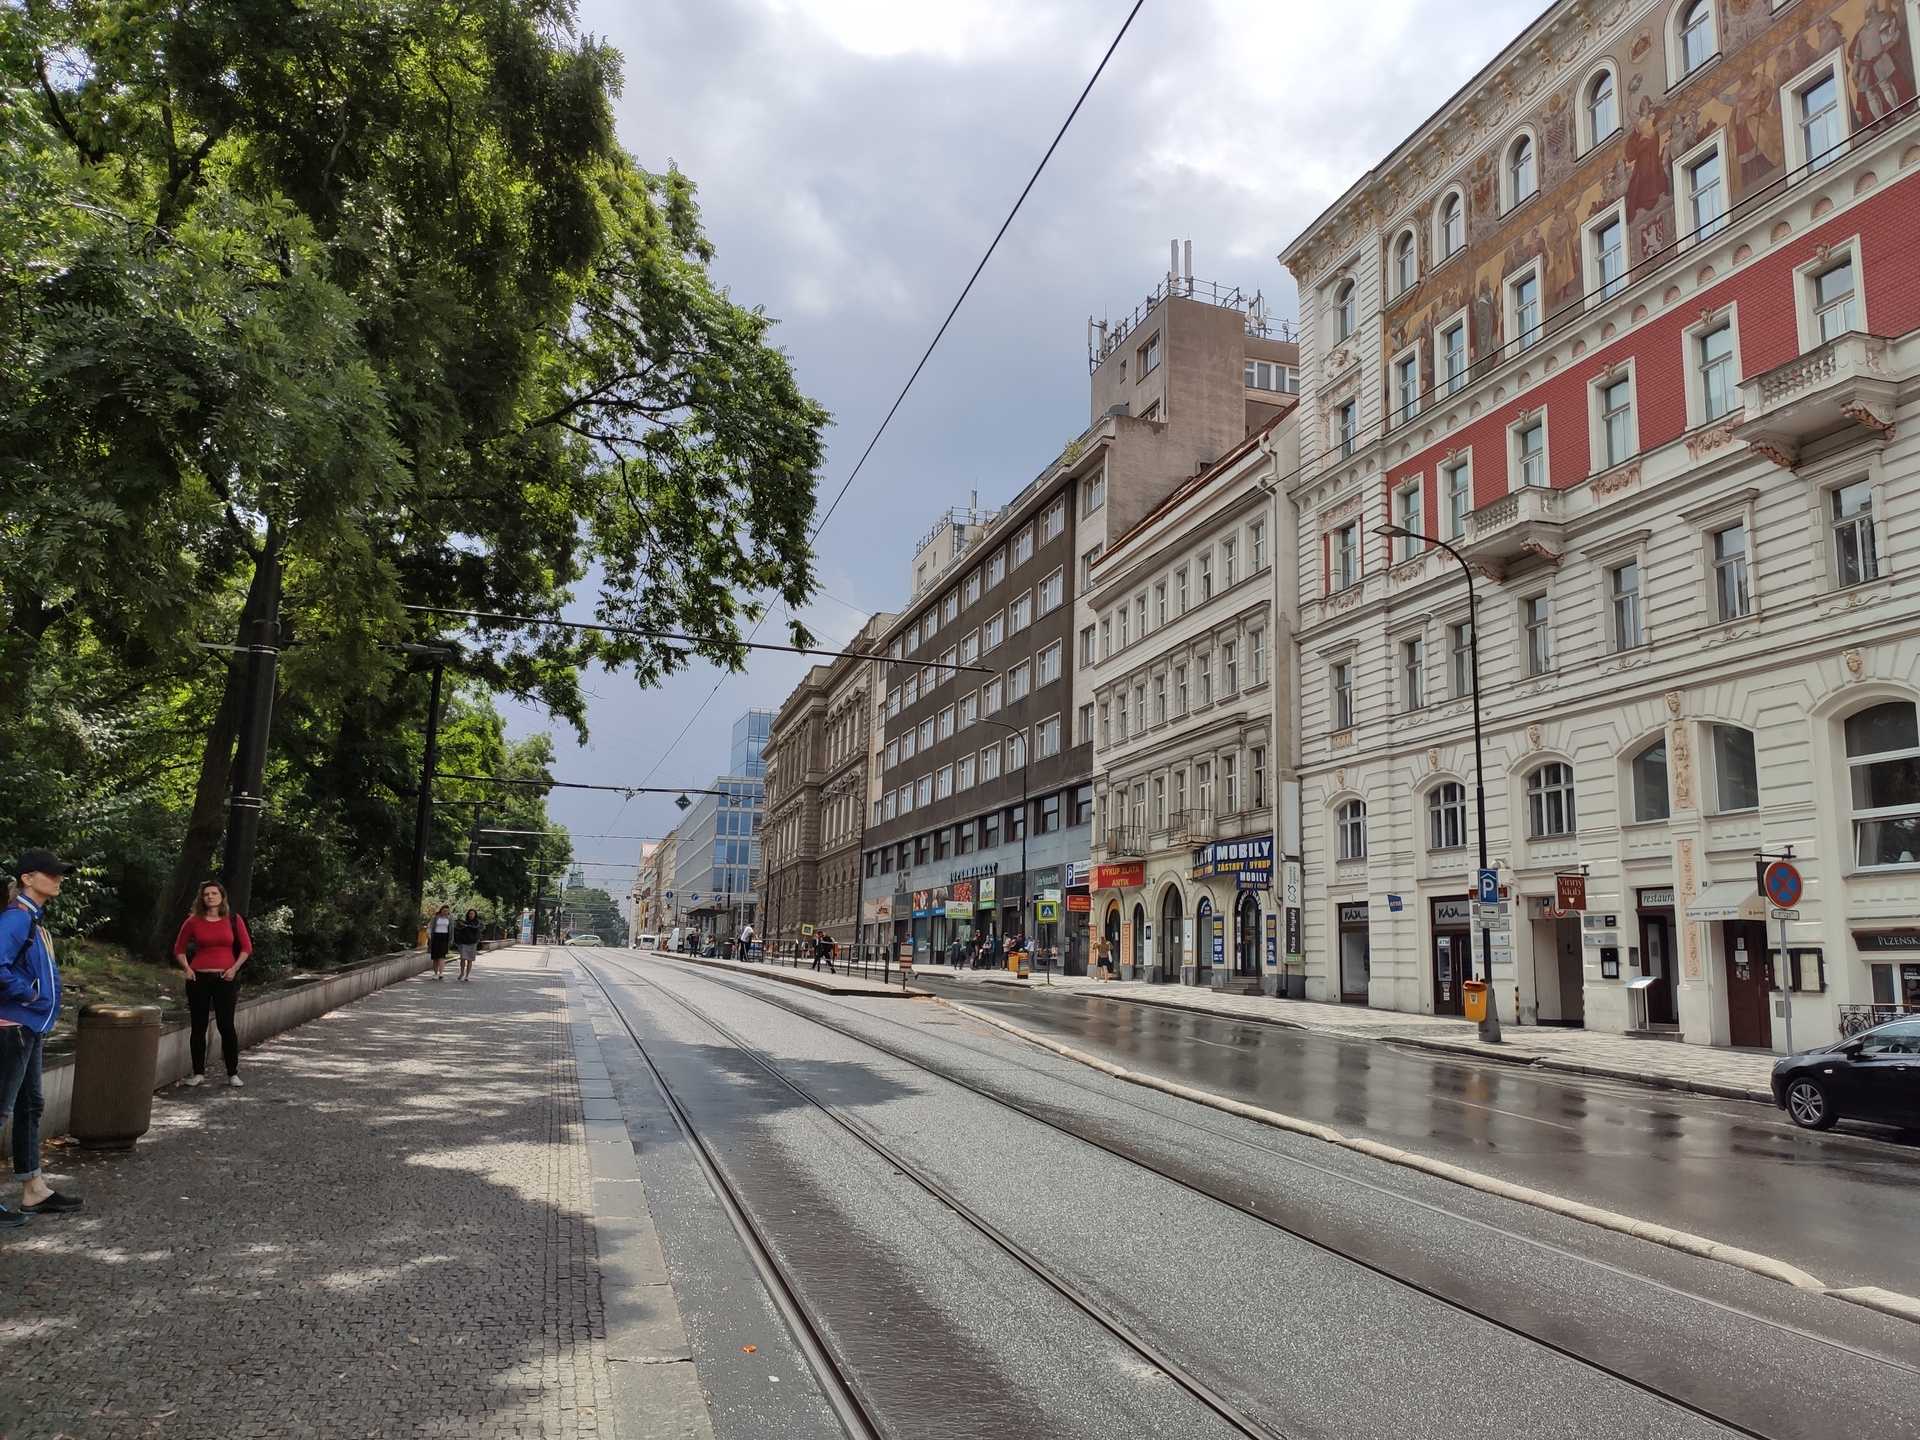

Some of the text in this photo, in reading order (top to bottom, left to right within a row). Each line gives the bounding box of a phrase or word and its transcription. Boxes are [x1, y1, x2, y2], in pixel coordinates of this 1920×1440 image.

[1216, 841, 1271, 861] MOBILY
[1101, 865, 1140, 877] VÝKUP ZLATA
[1217, 861, 1245, 872] ZÁSTAVY
[1249, 859, 1271, 870] VÝKUP
[1111, 878, 1130, 887] ANTIK
[1240, 871, 1267, 882] MOBILY
[1562, 886, 1581, 896] klub
[1643, 893, 1675, 904] restaura
[1344, 909, 1361, 921] KÁJA
[1438, 905, 1460, 919] KÁJA
